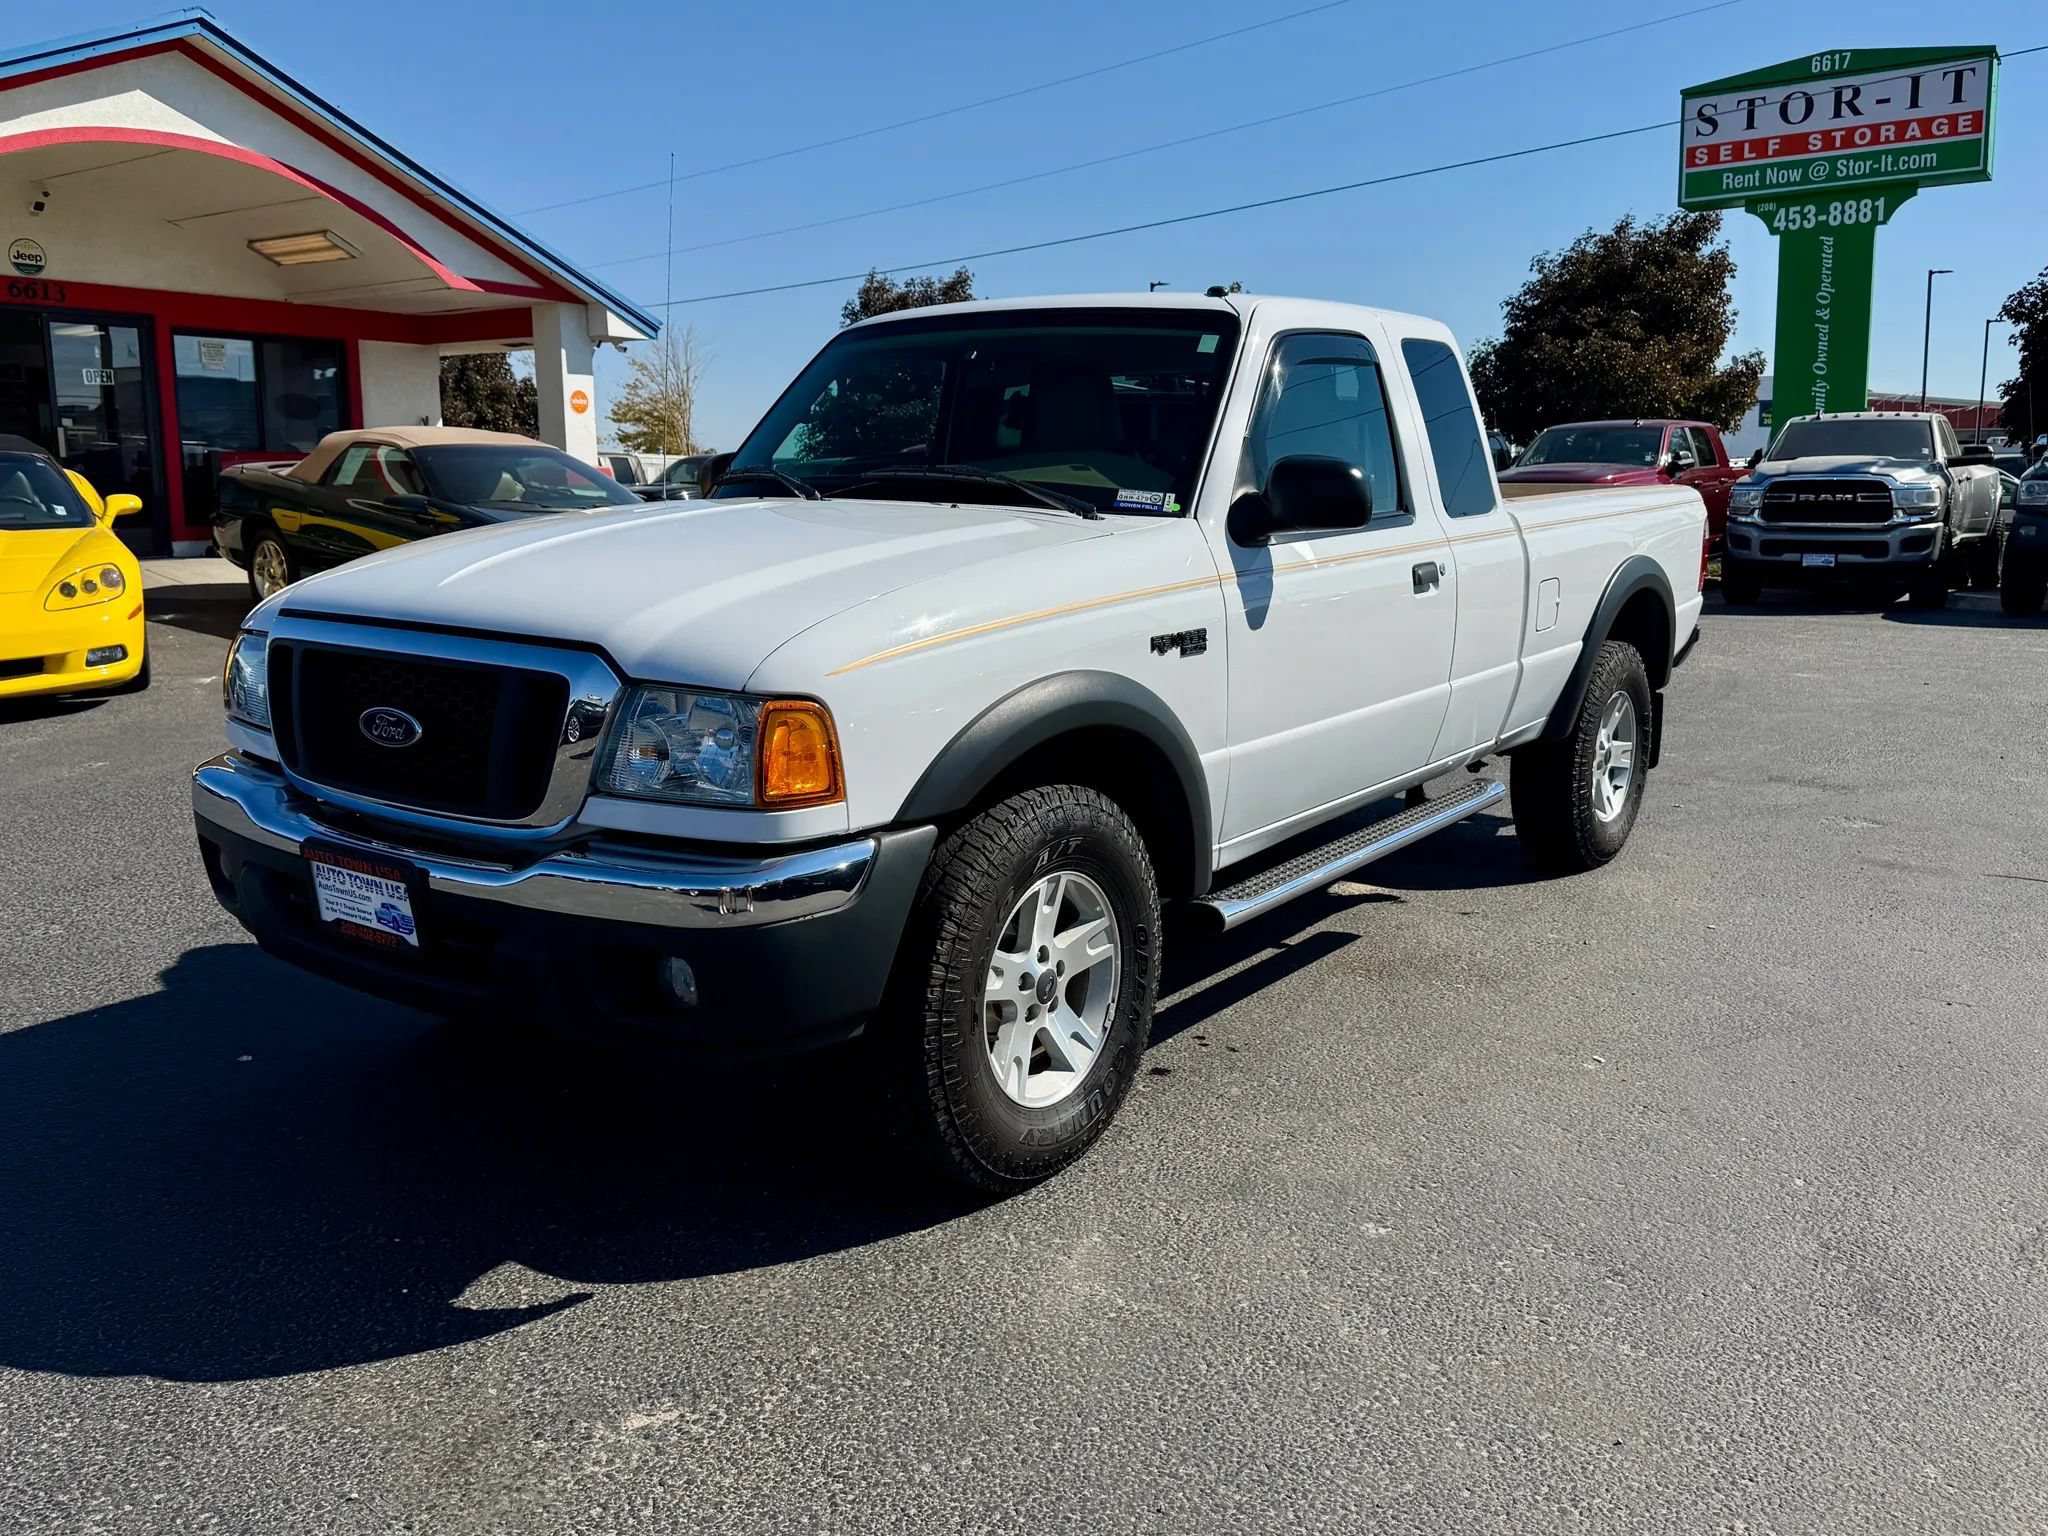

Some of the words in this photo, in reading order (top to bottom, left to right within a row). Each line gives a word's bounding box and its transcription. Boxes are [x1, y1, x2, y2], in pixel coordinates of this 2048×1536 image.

[1811, 52, 1851, 73] 6617
[1695, 67, 1976, 138] STOR-IT
[1695, 139, 1781, 164] SELF
[1808, 114, 1973, 150] STORAGE
[1722, 169, 1760, 190] Rent
[1766, 165, 1802, 184] Now
[1808, 160, 1830, 181] @
[1836, 152, 1937, 177] Stor-It.com
[1757, 201, 1776, 213] (208)
[1773, 197, 1885, 231] 453-8881
[12, 250, 43, 264] Jeep
[1816, 236, 1835, 305] Operated
[7, 281, 67, 303] 6613
[1815, 307, 1830, 321] &
[1812, 323, 1829, 375] Owned
[85, 369, 113, 383] OPEN
[1799, 494, 1854, 502] RAM
[372, 713, 405, 740] Ford
[1032, 836, 1084, 874] A/T
[316, 864, 346, 886] AUTO
[346, 872, 385, 897] TOWN
[1127, 923, 1150, 1036] OPEN
[1019, 1045, 1128, 1147] COUNTRY
